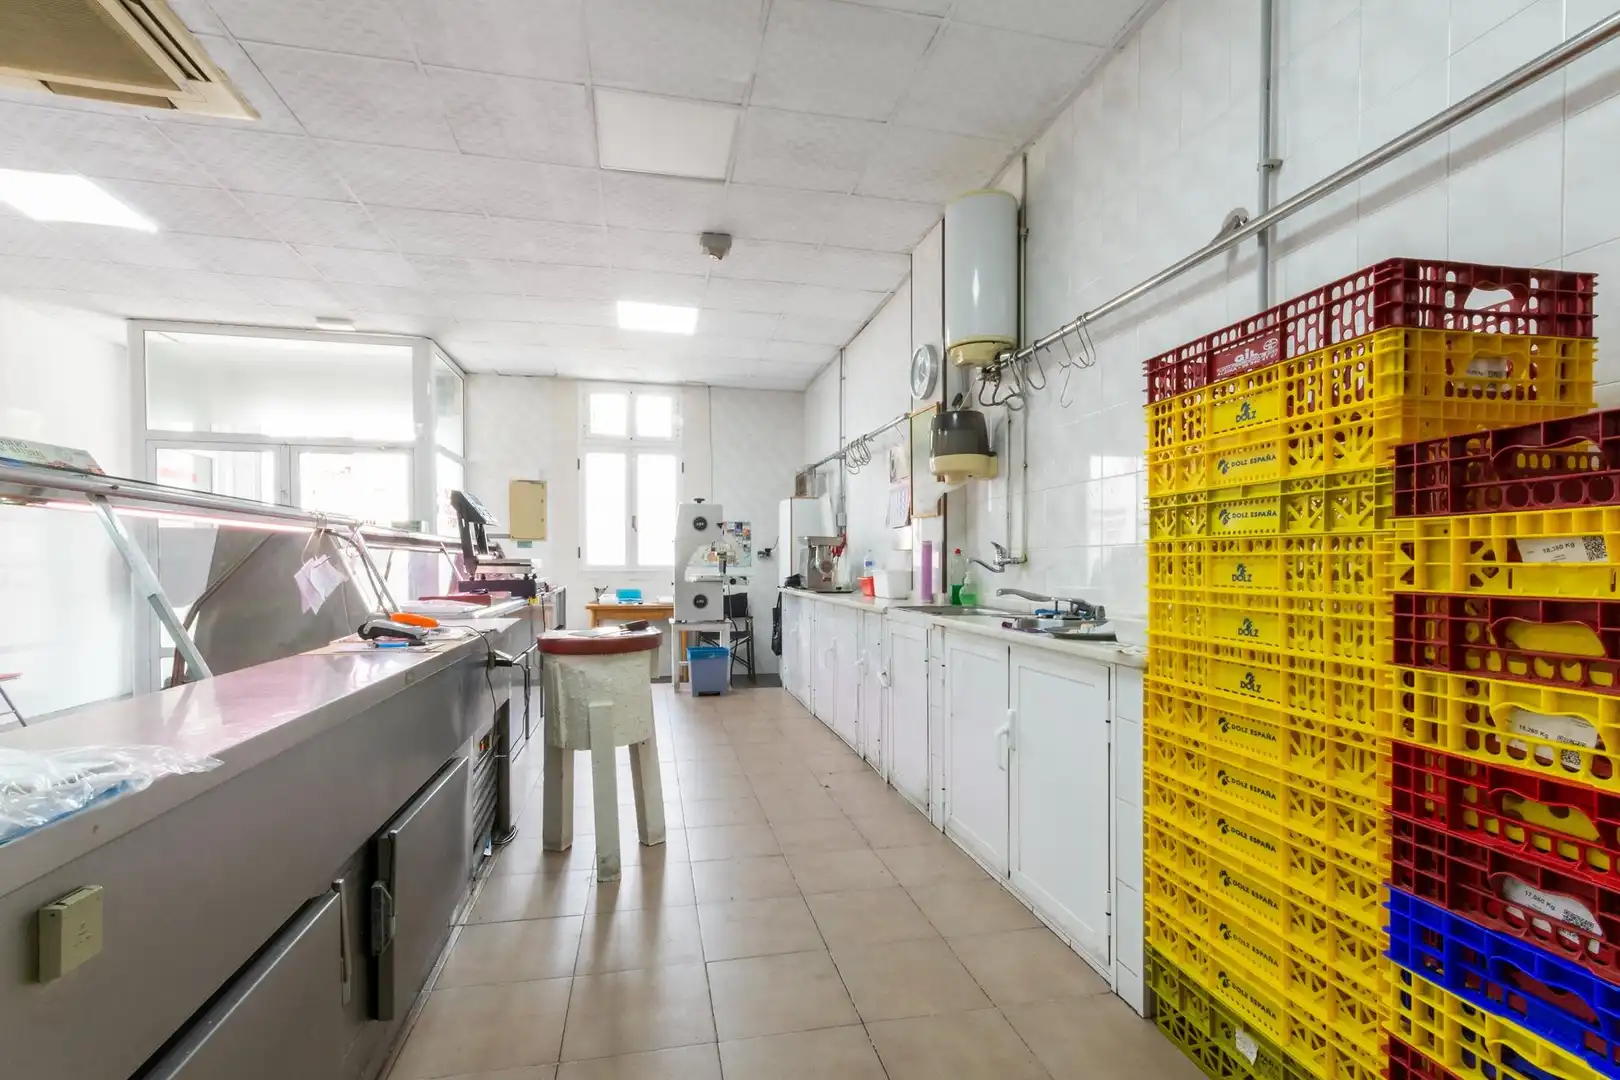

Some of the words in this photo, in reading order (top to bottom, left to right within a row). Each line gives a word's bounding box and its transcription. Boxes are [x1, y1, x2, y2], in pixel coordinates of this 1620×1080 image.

[1236, 410, 1257, 422] DOLZ
[1231, 459, 1248, 468] DOLZ
[1250, 453, 1277, 465] ESPAÑA
[1231, 511, 1248, 519] DOLZ
[1250, 508, 1278, 518] ESPAÑA
[1231, 573, 1252, 582] DOLZ
[1237, 627, 1259, 637] DOLZ
[1240, 681, 1262, 693] DOLZ
[1231, 724, 1248, 734] DOLZ
[1249, 729, 1277, 742] ESPAÑA
[1231, 777, 1248, 789] DOLZ
[1249, 784, 1277, 800] ESPAÑA
[1230, 827, 1248, 839] DOLZ
[1249, 835, 1277, 853] ESPAÑA
[1232, 879, 1250, 894] DOLZ
[1251, 890, 1279, 911] ESPAÑA
[1232, 933, 1250, 949] DOLZ
[1251, 945, 1279, 968] ESPAÑA
[1231, 982, 1249, 999] DOLZ
[1250, 996, 1277, 1020] ESPAÑA
